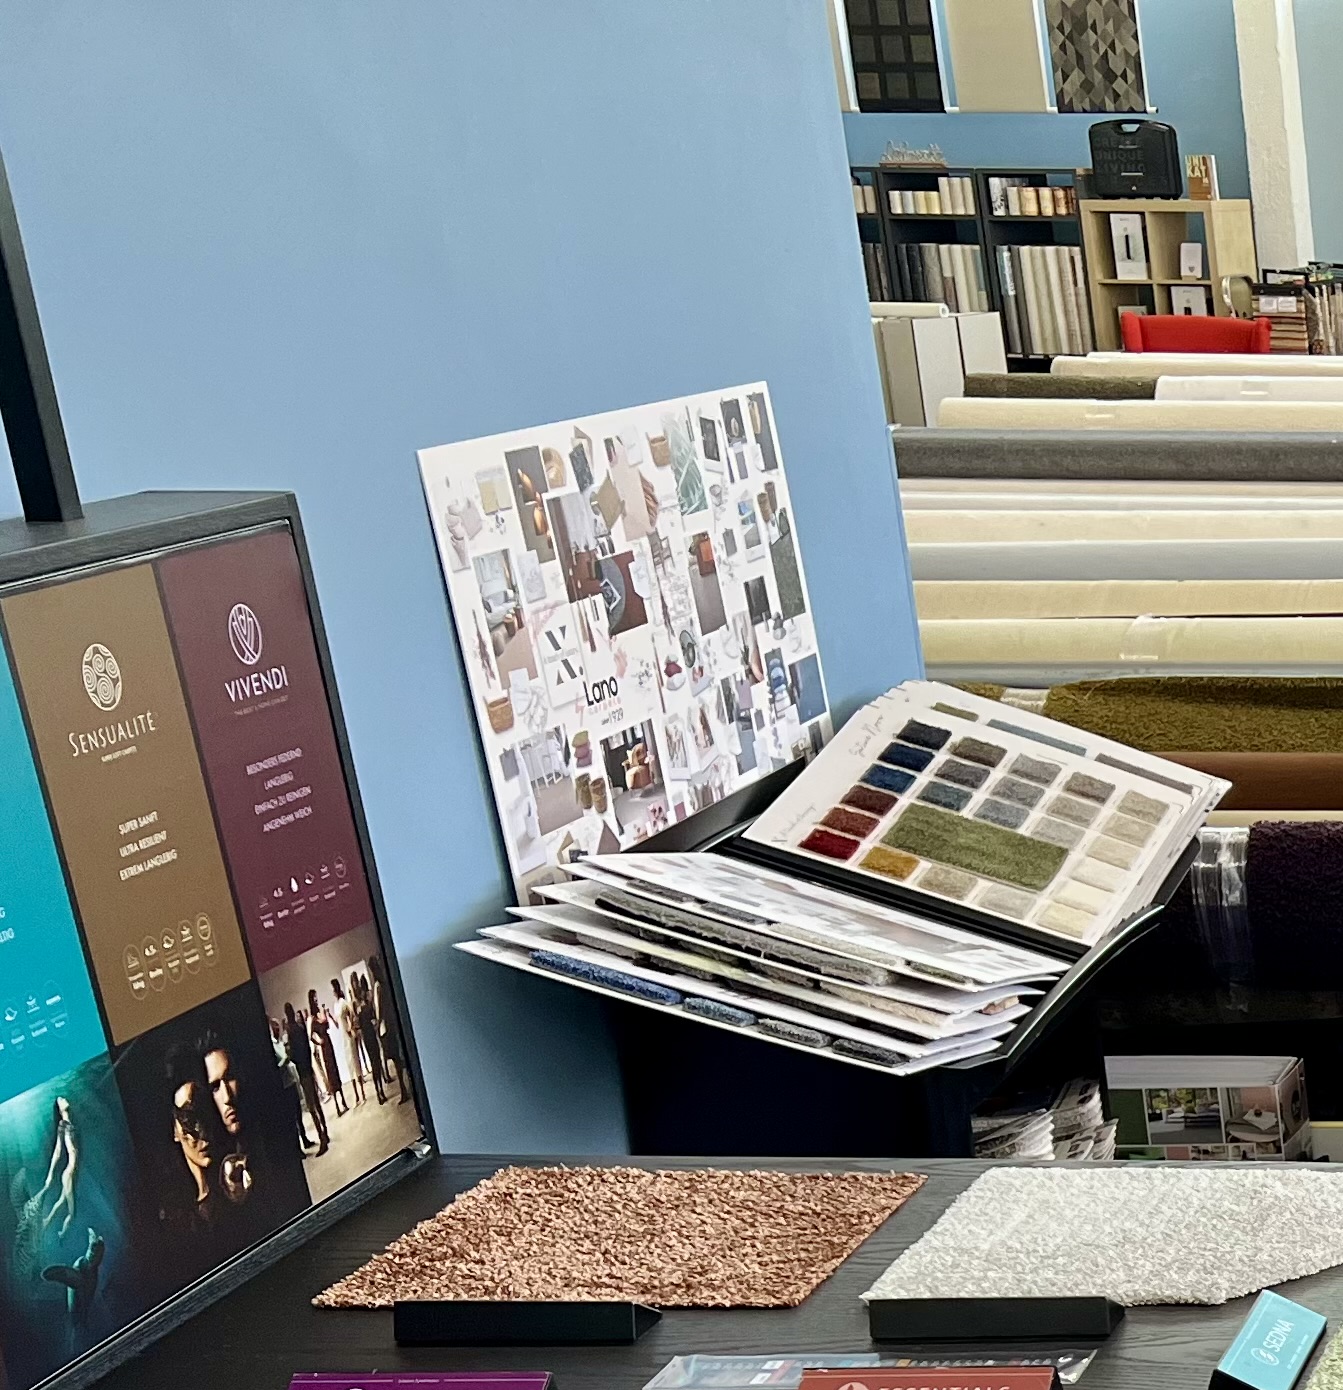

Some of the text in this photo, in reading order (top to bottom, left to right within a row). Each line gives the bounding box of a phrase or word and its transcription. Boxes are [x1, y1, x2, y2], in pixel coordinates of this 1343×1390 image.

[225, 665, 289, 703] VIVENDI
[582, 676, 619, 707] Lano
[68, 710, 156, 757] SENSUALITÉ
[1263, 1319, 1295, 1353] SEDNA
